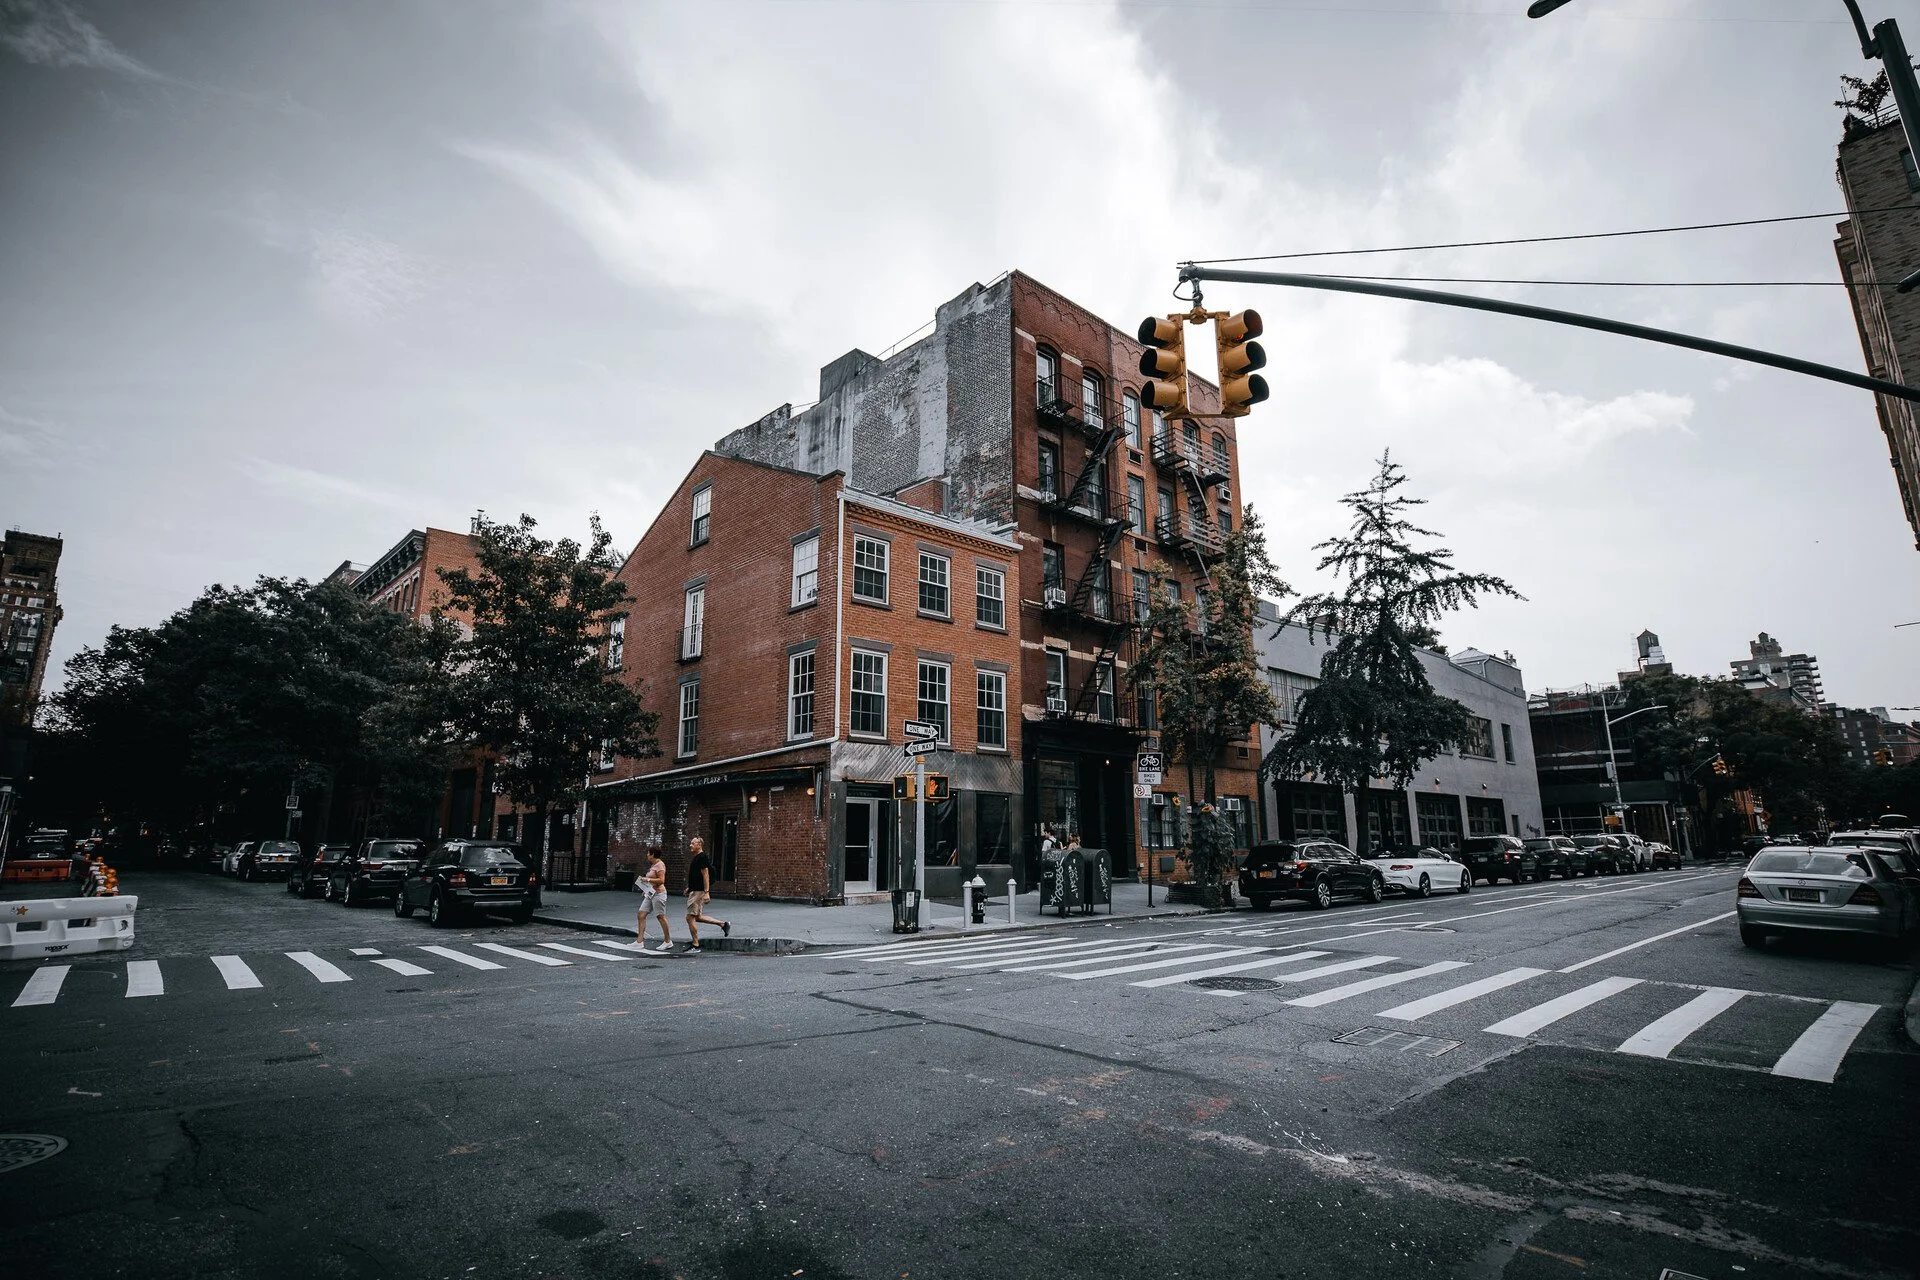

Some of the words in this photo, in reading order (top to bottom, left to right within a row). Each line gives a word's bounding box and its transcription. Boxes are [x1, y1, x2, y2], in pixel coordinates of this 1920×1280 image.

[909, 725, 919, 733] ONE
[922, 742, 932, 750] WAY
[977, 902, 984, 910] 12
